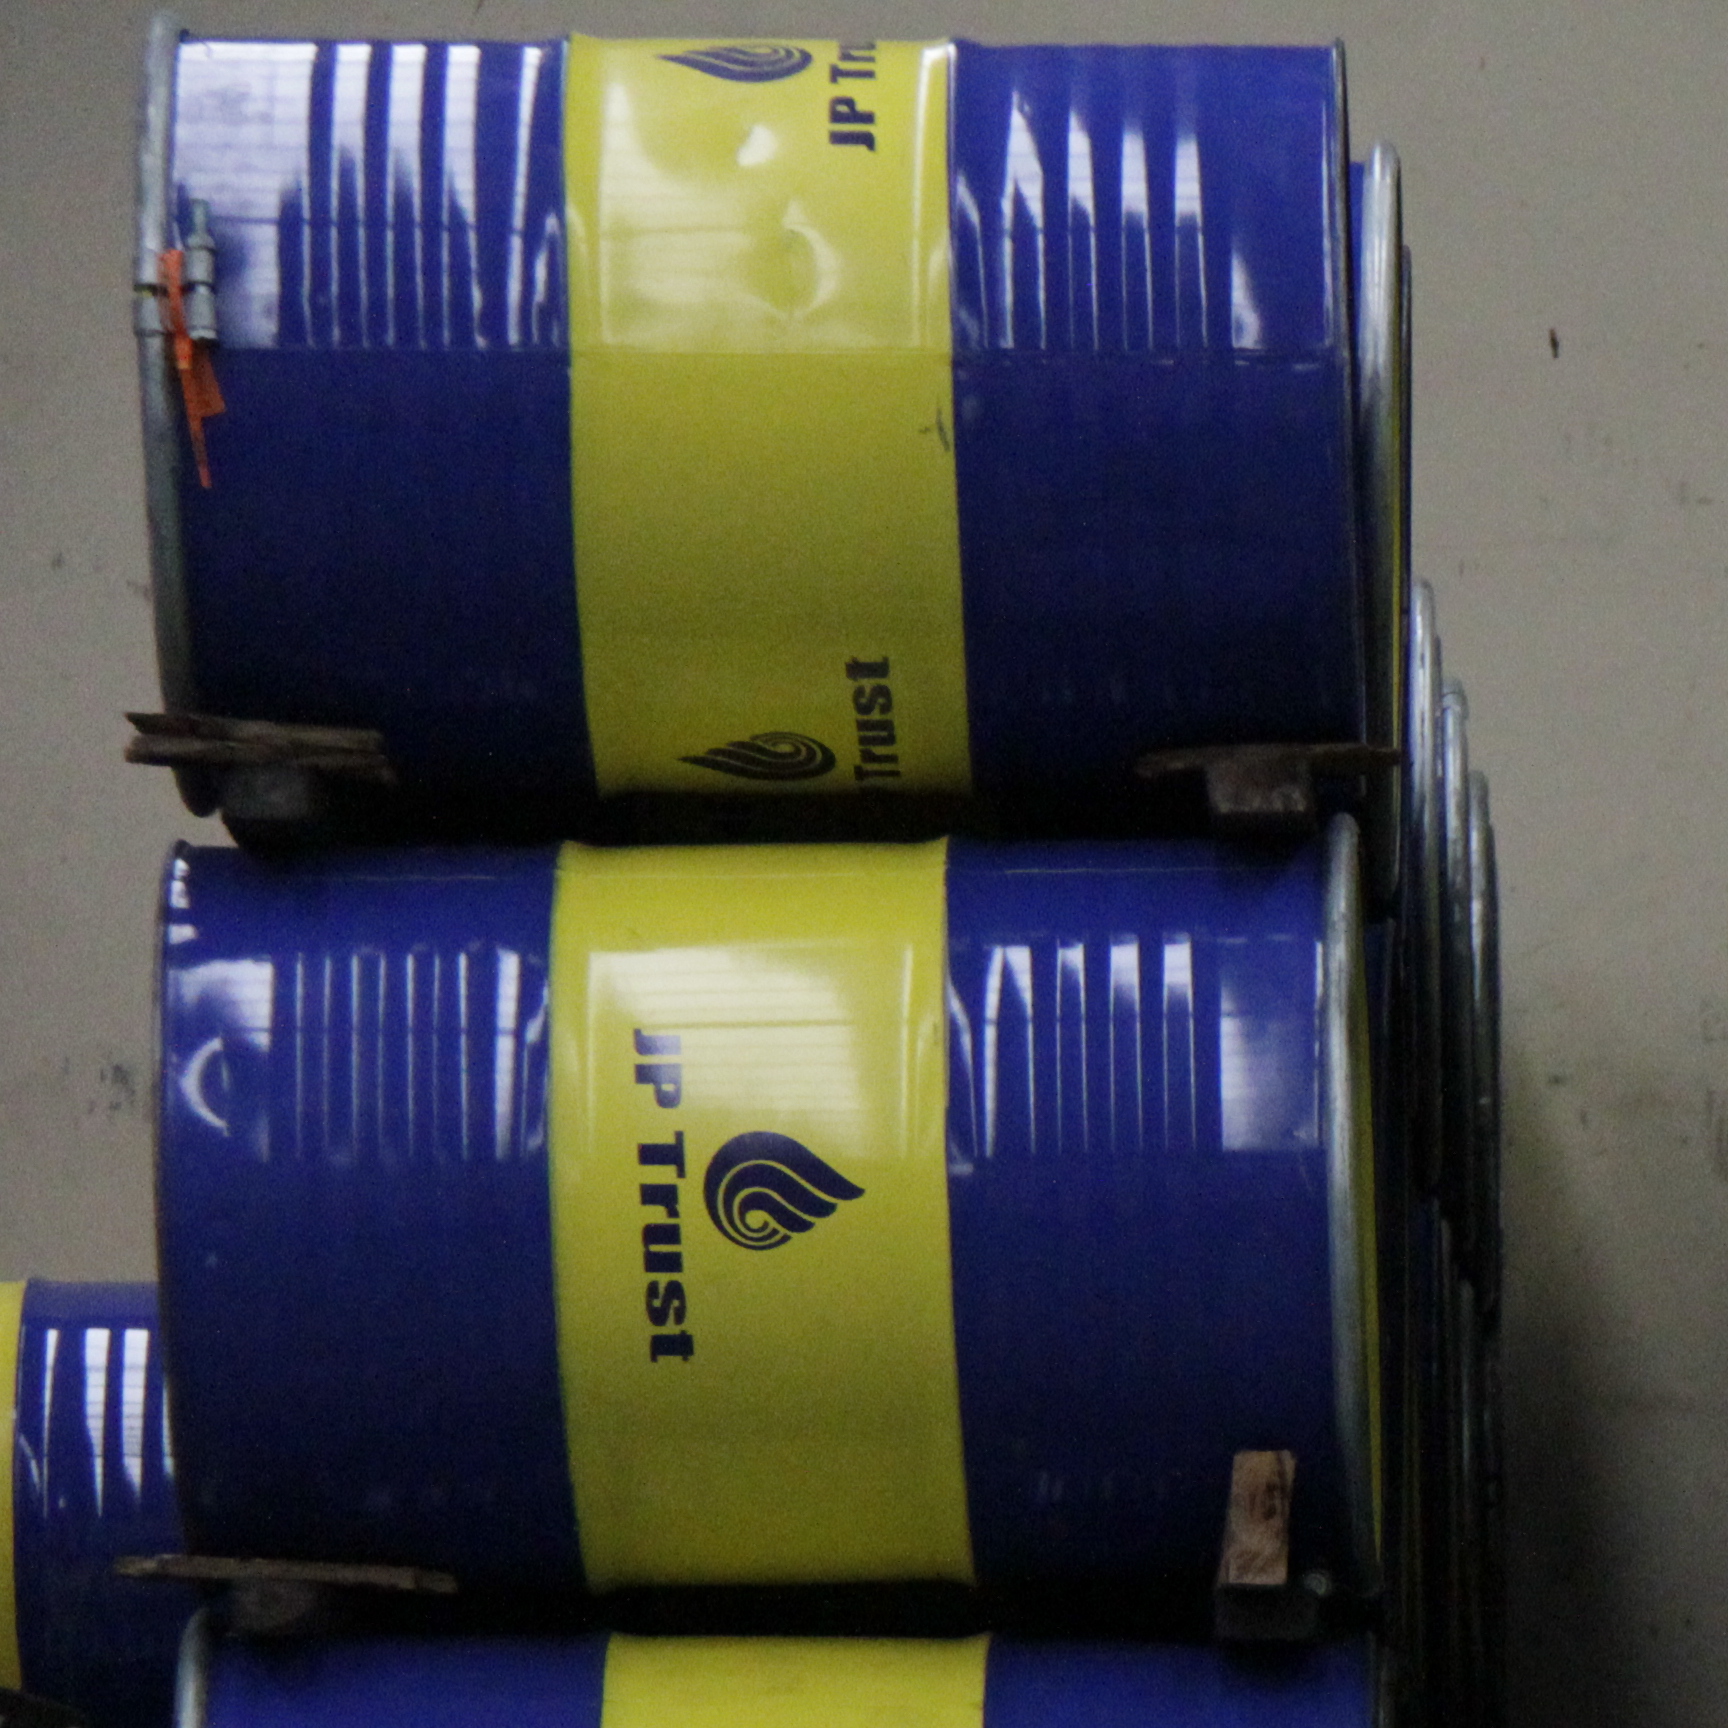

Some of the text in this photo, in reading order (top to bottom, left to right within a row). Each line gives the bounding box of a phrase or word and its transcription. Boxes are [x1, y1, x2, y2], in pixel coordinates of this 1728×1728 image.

[829, 96, 875, 151] JP
[845, 656, 900, 782] Trust
[633, 1027, 694, 1363] JP Trust
